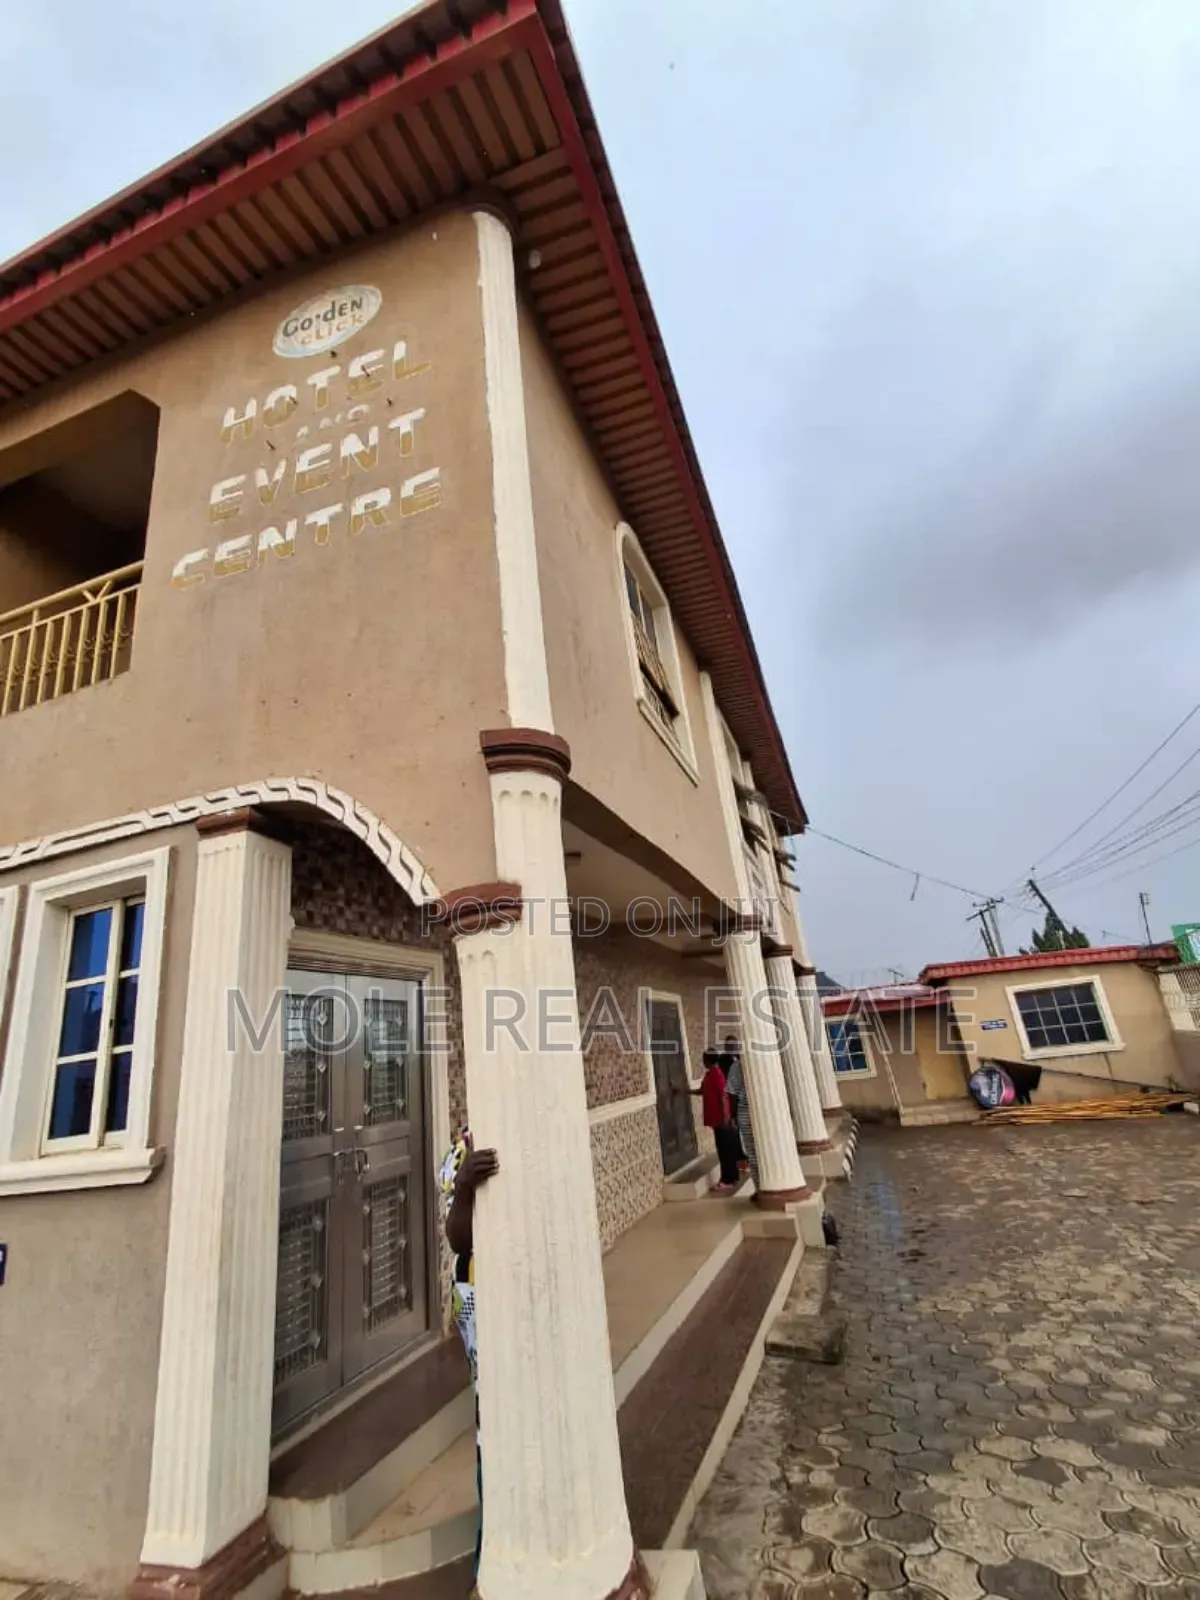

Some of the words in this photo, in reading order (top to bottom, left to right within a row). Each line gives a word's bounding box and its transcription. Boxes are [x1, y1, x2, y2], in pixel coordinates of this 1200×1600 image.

[219, 340, 431, 446] HOTEL
[208, 407, 427, 523] EVENT
[168, 466, 442, 592] CENTRE
